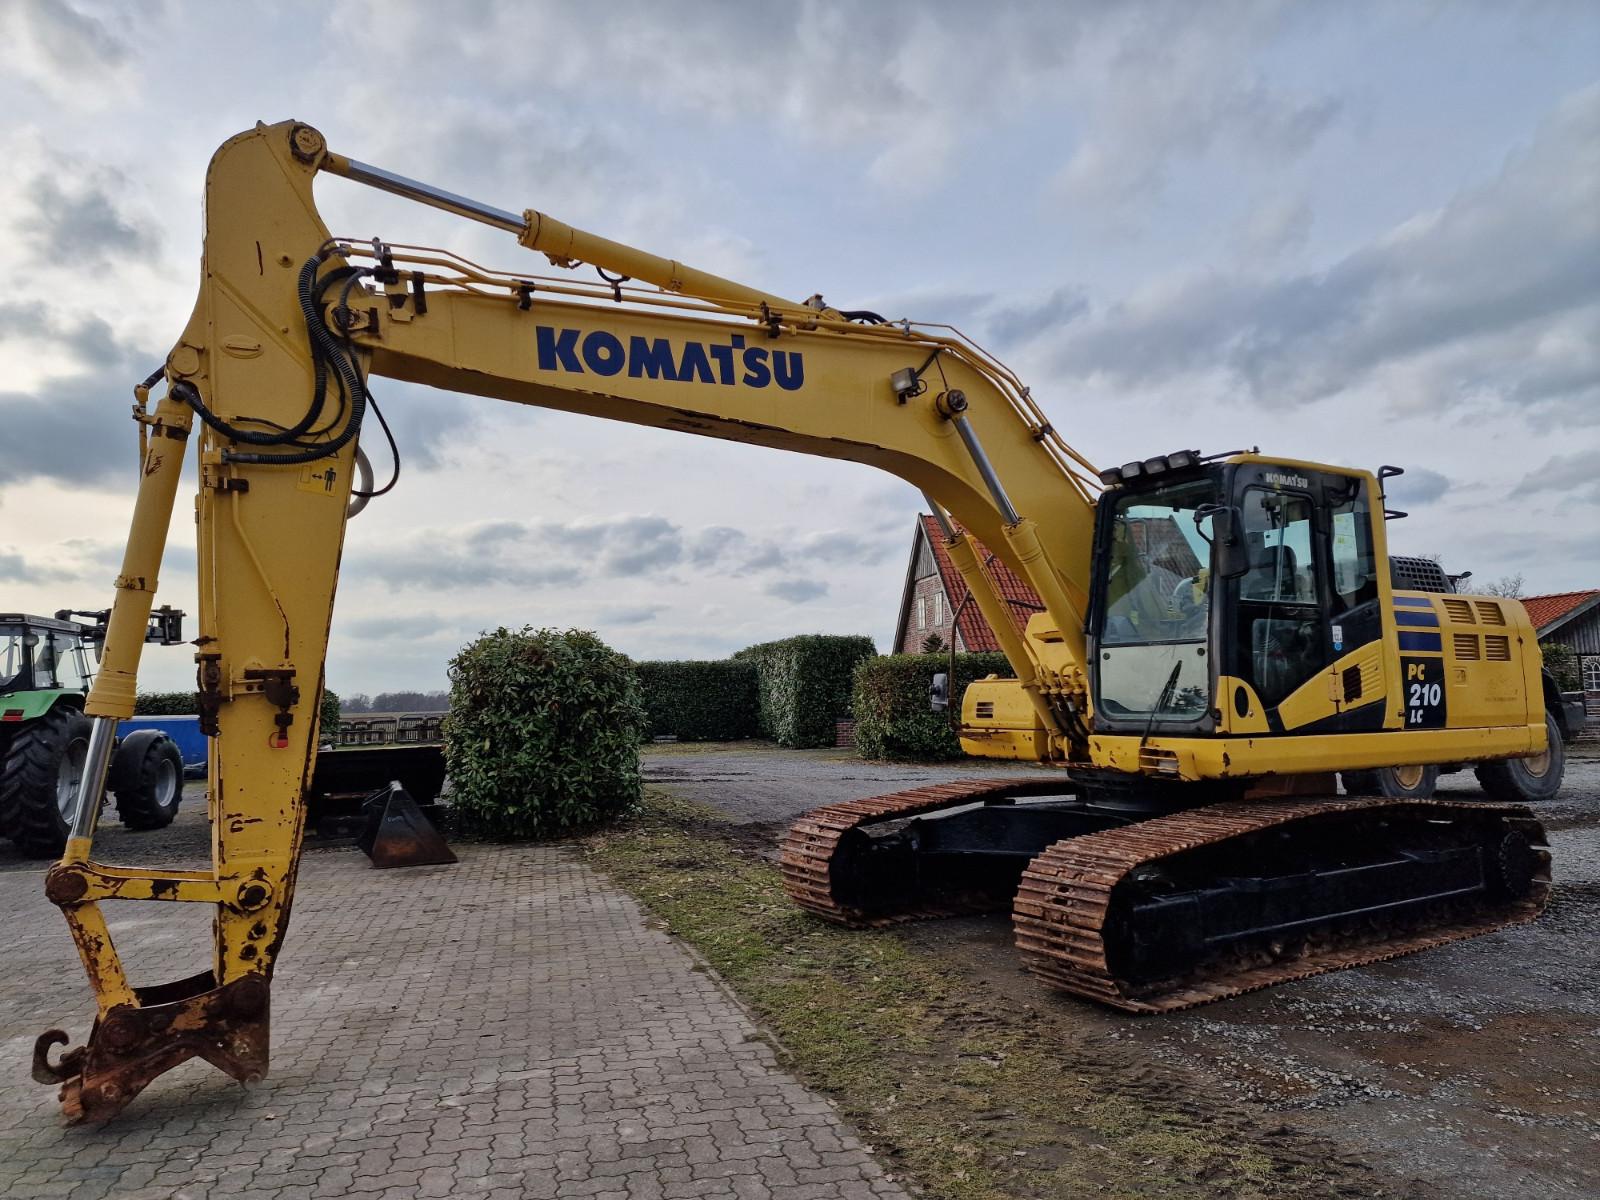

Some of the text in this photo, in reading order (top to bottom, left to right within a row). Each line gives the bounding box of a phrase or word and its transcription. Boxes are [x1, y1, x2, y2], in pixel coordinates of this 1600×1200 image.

[535, 325, 805, 391] KOMATSU
[1265, 472, 1308, 489] KOMATSU
[1407, 663, 1426, 681] PC
[1409, 683, 1442, 707] 210
[1409, 709, 1424, 724] LC
